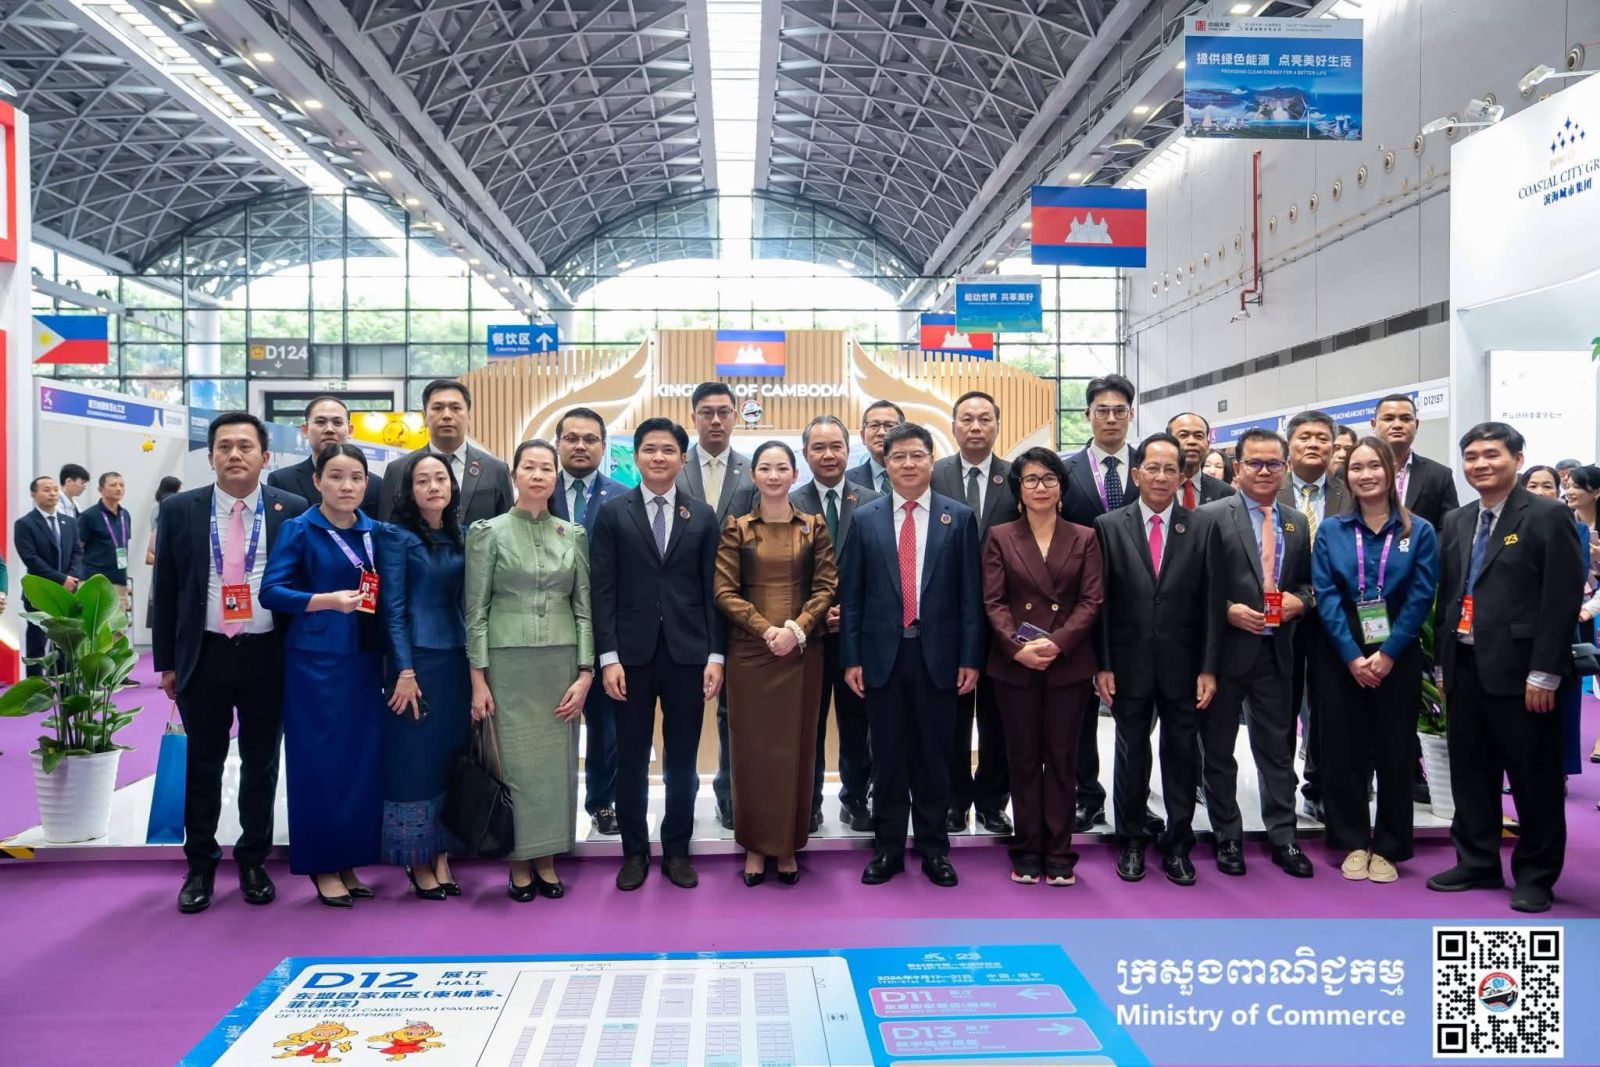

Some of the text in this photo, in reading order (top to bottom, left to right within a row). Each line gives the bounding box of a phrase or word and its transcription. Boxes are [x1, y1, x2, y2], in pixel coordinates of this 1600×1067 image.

[1196, 52, 1352, 68] 提供绿色能源 点亮美好生活
[1518, 174, 1558, 200] COASTAL
[1560, 163, 1584, 183] CITY
[1543, 177, 1592, 206] 滨海城市集团
[492, 332, 531, 346] 餐饮区
[266, 344, 309, 360] D124
[736, 383, 758, 398] OF
[761, 383, 850, 398] CAMBODIA
[1423, 393, 1444, 406] D12157
[1503, 533, 1519, 546] 23
[303, 971, 419, 989] D12
[441, 970, 488, 979] 展厅
[880, 991, 934, 1002] D11
[892, 1026, 957, 1040] D13
